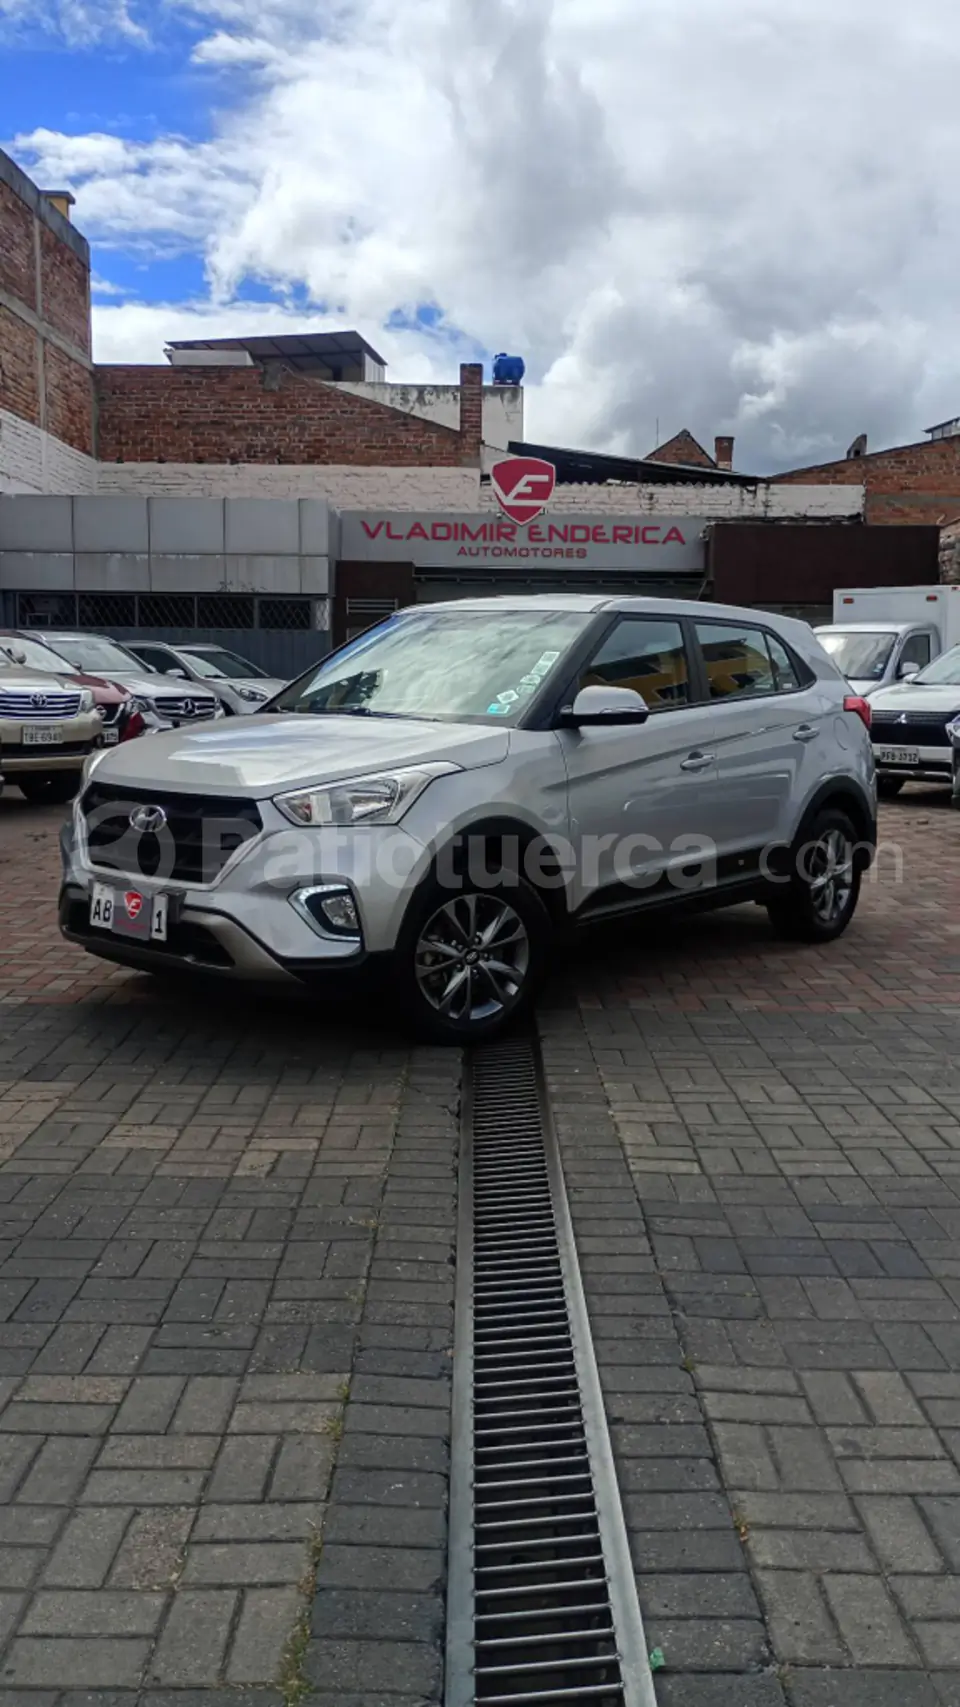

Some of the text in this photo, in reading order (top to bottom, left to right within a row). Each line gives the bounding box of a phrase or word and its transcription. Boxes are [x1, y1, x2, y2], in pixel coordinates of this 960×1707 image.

[361, 521, 686, 545] VLADIMIR ENDERICA
[457, 546, 587, 559] AUTOMOTORES
